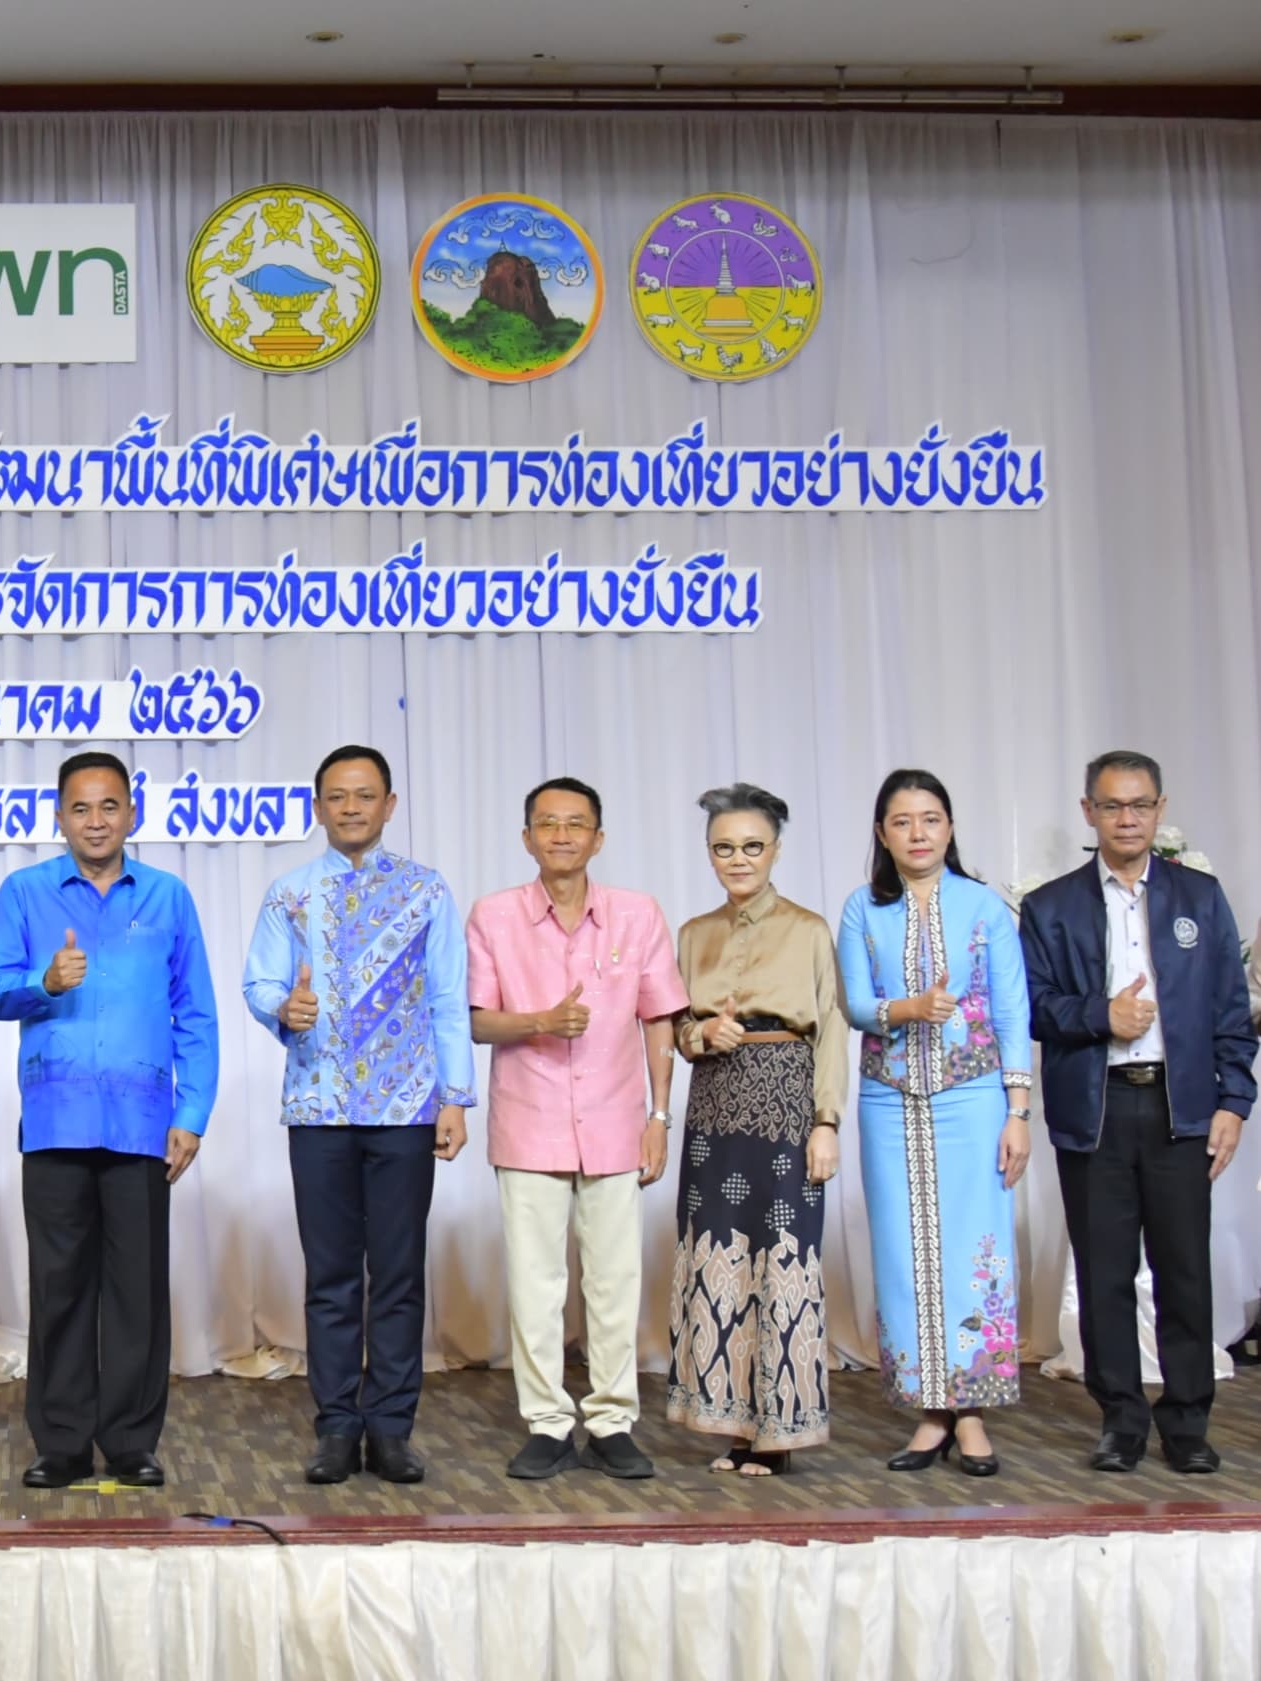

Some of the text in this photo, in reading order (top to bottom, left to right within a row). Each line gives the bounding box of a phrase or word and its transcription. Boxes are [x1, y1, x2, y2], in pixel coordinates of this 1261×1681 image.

[114, 269, 128, 314] DASTA
[129, 668, 262, 735] ๒๕๖๖
[166, 772, 314, 838] สงขลา
